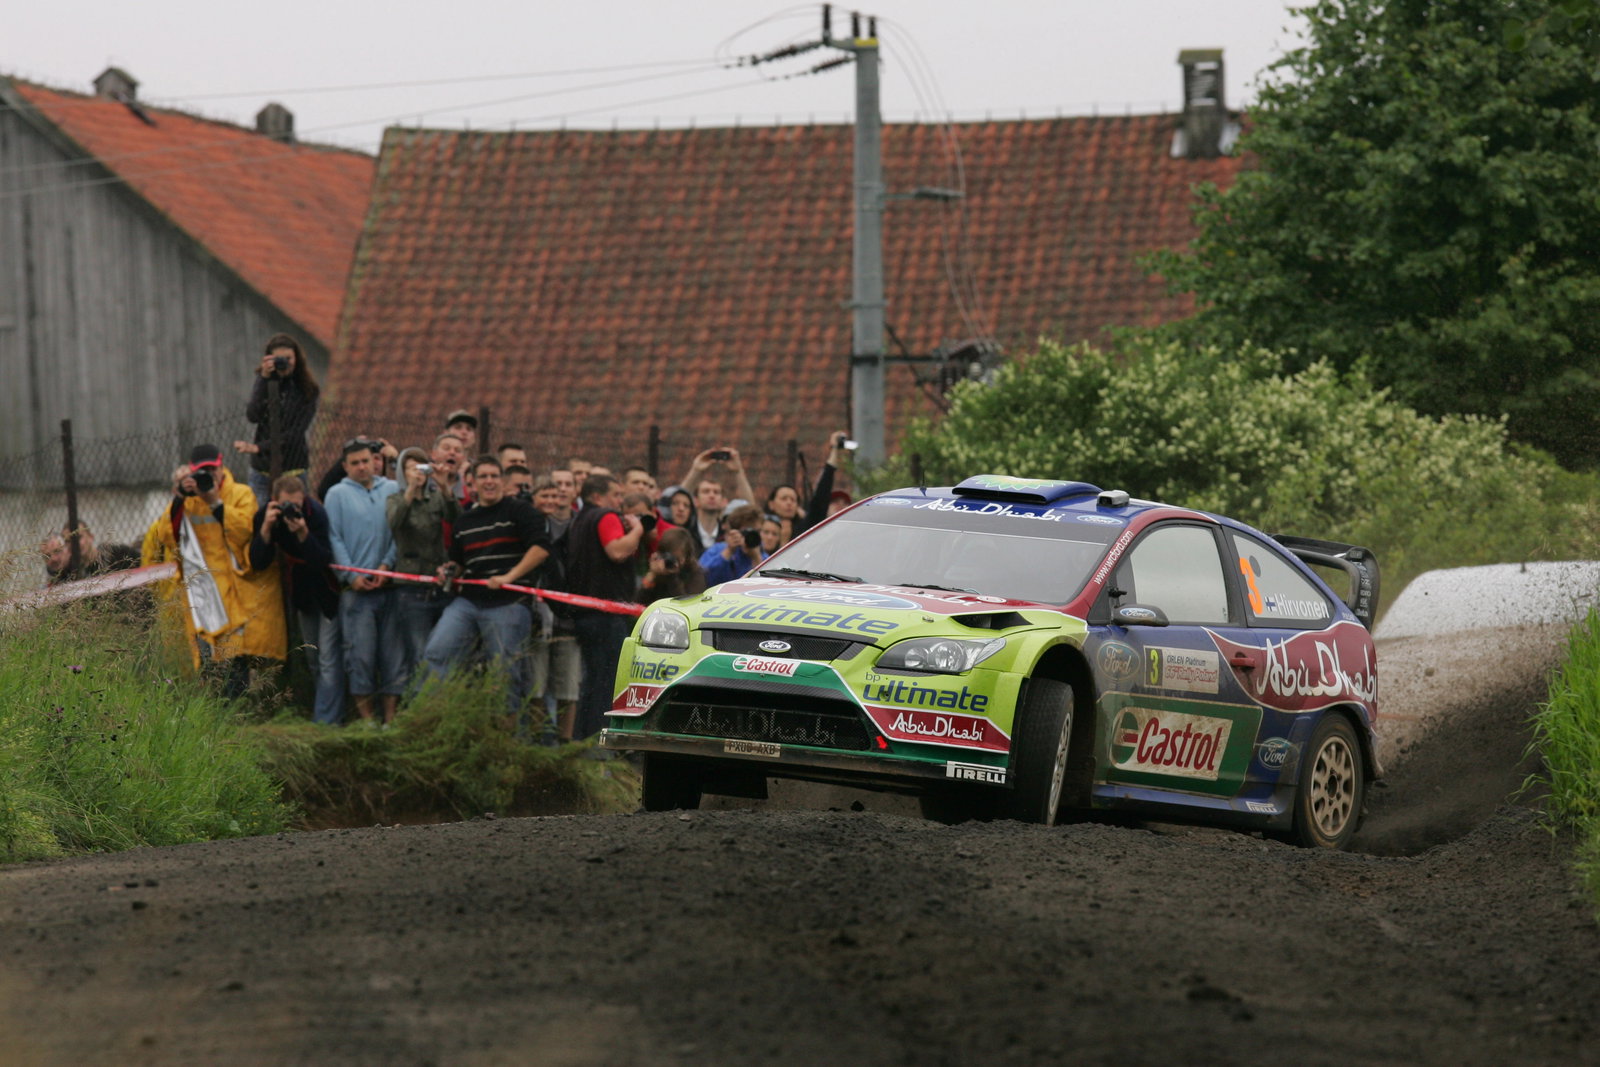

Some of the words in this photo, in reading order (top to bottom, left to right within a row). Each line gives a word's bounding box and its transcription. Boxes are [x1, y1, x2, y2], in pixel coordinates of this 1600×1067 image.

[913, 498, 979, 514] Abu
[980, 503, 1066, 522] Dhabi
[1094, 530, 1134, 585] www.wrcford.com
[770, 590, 890, 605] Ford
[1239, 557, 1263, 615] 3
[702, 602, 899, 635] ultimate
[1124, 608, 1150, 618] Ford
[1275, 594, 1330, 619] Hirvonen
[747, 658, 794, 675] Castrol
[1104, 646, 1131, 673] Ford
[1150, 649, 1159, 685] 3
[1256, 637, 1312, 697] Abu
[1310, 639, 1378, 703] Dhabi
[865, 672, 881, 683] bp
[862, 680, 989, 712] ultimate
[746, 709, 838, 745] Dhabi
[889, 712, 935, 736] Abu
[935, 716, 984, 741] Dhabi
[1137, 717, 1223, 771] Castrol
[1263, 744, 1287, 764] Ford
[946, 760, 1007, 784] PIRELLI
